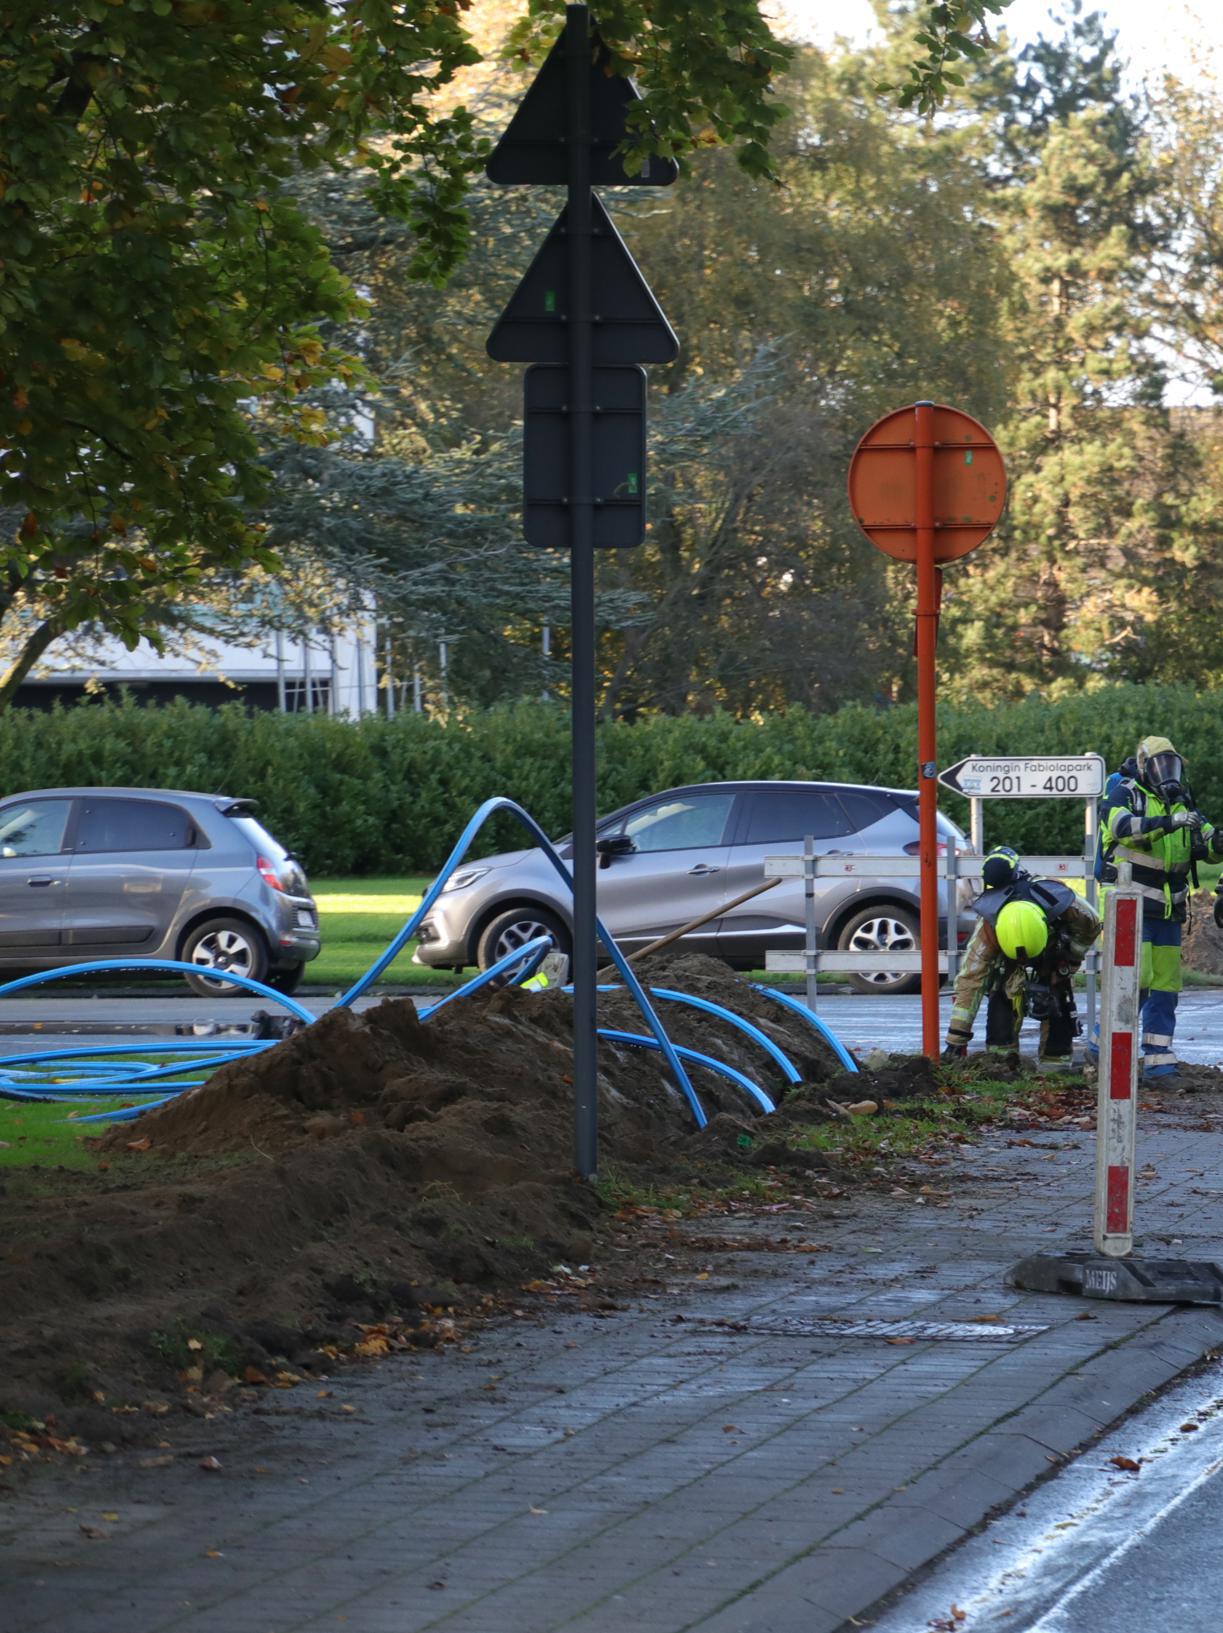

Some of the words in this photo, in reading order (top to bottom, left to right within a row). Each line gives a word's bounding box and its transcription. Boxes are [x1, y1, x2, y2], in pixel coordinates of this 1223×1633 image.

[971, 762, 1020, 774] Koningin
[1024, 761, 1092, 773] Fabiolapark
[990, 776, 1021, 793] 201
[1043, 776, 1078, 792] 400
